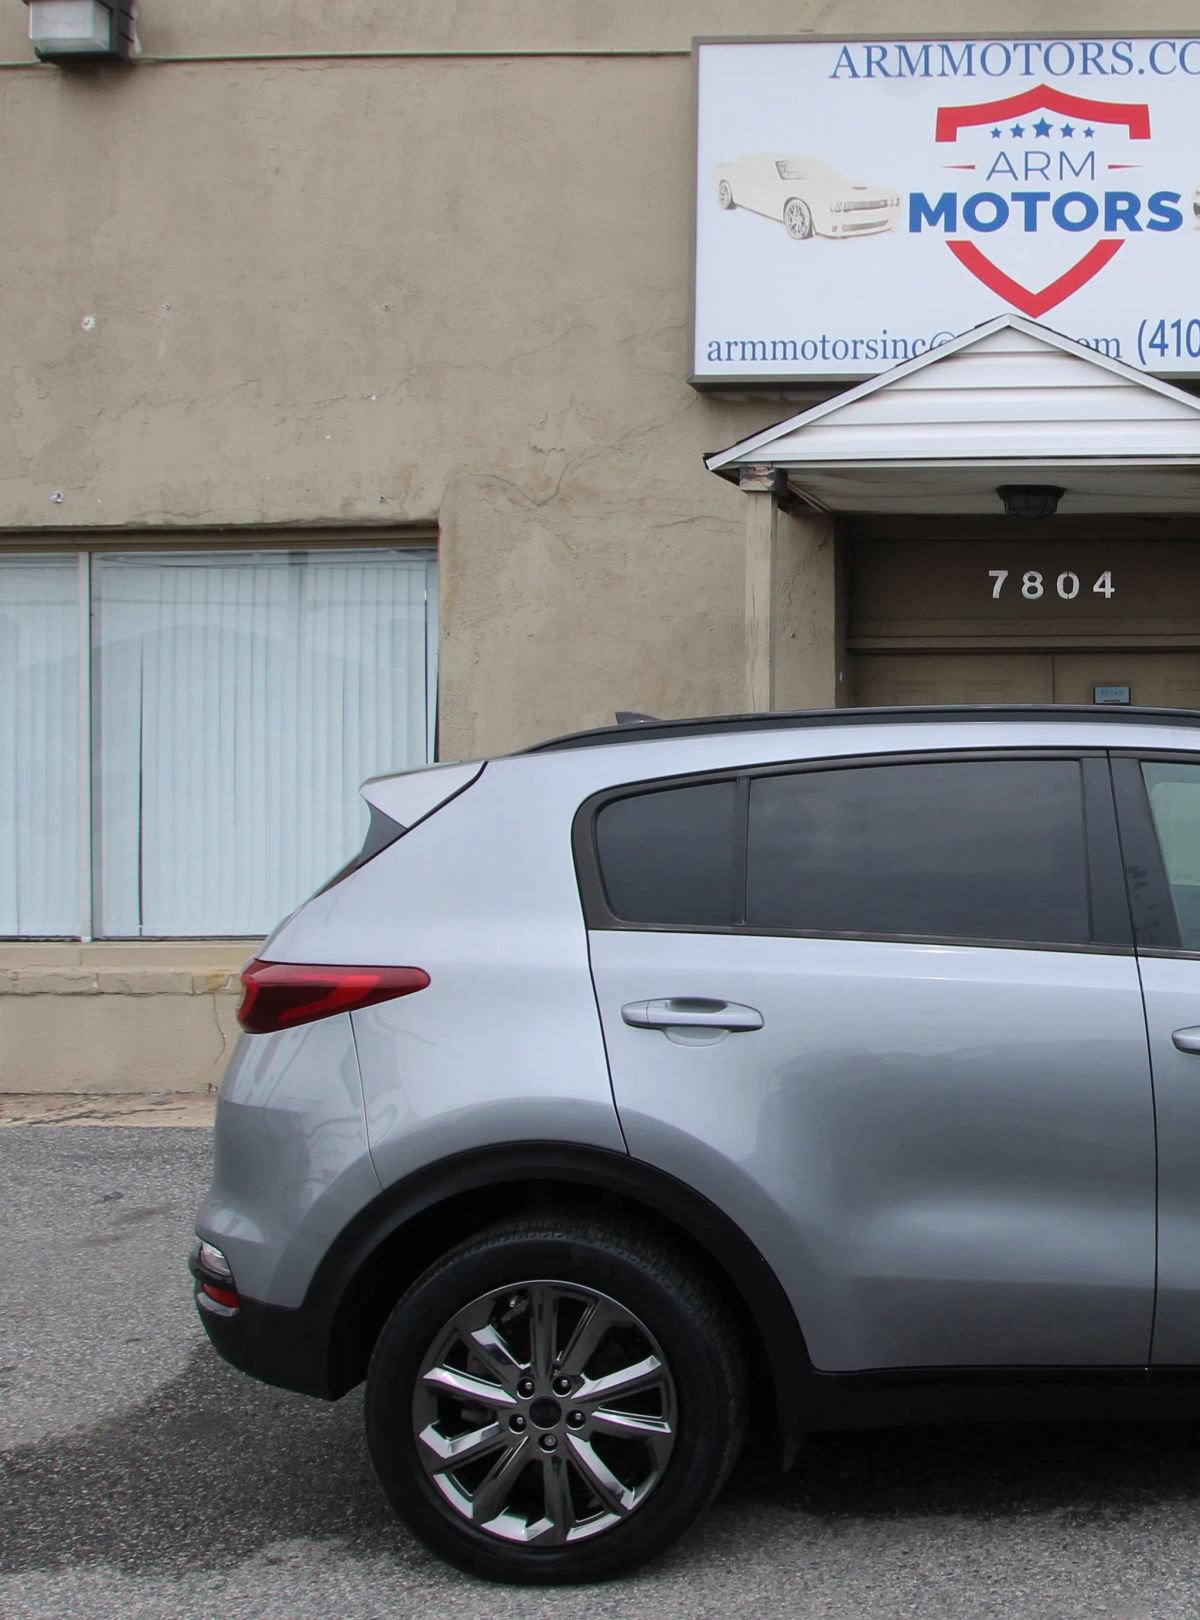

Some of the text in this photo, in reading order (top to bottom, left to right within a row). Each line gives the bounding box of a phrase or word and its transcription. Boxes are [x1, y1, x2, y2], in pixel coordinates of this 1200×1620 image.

[986, 151, 1095, 181] ARM
[908, 191, 1183, 233] MOTORS
[988, 570, 1115, 599] 7804
